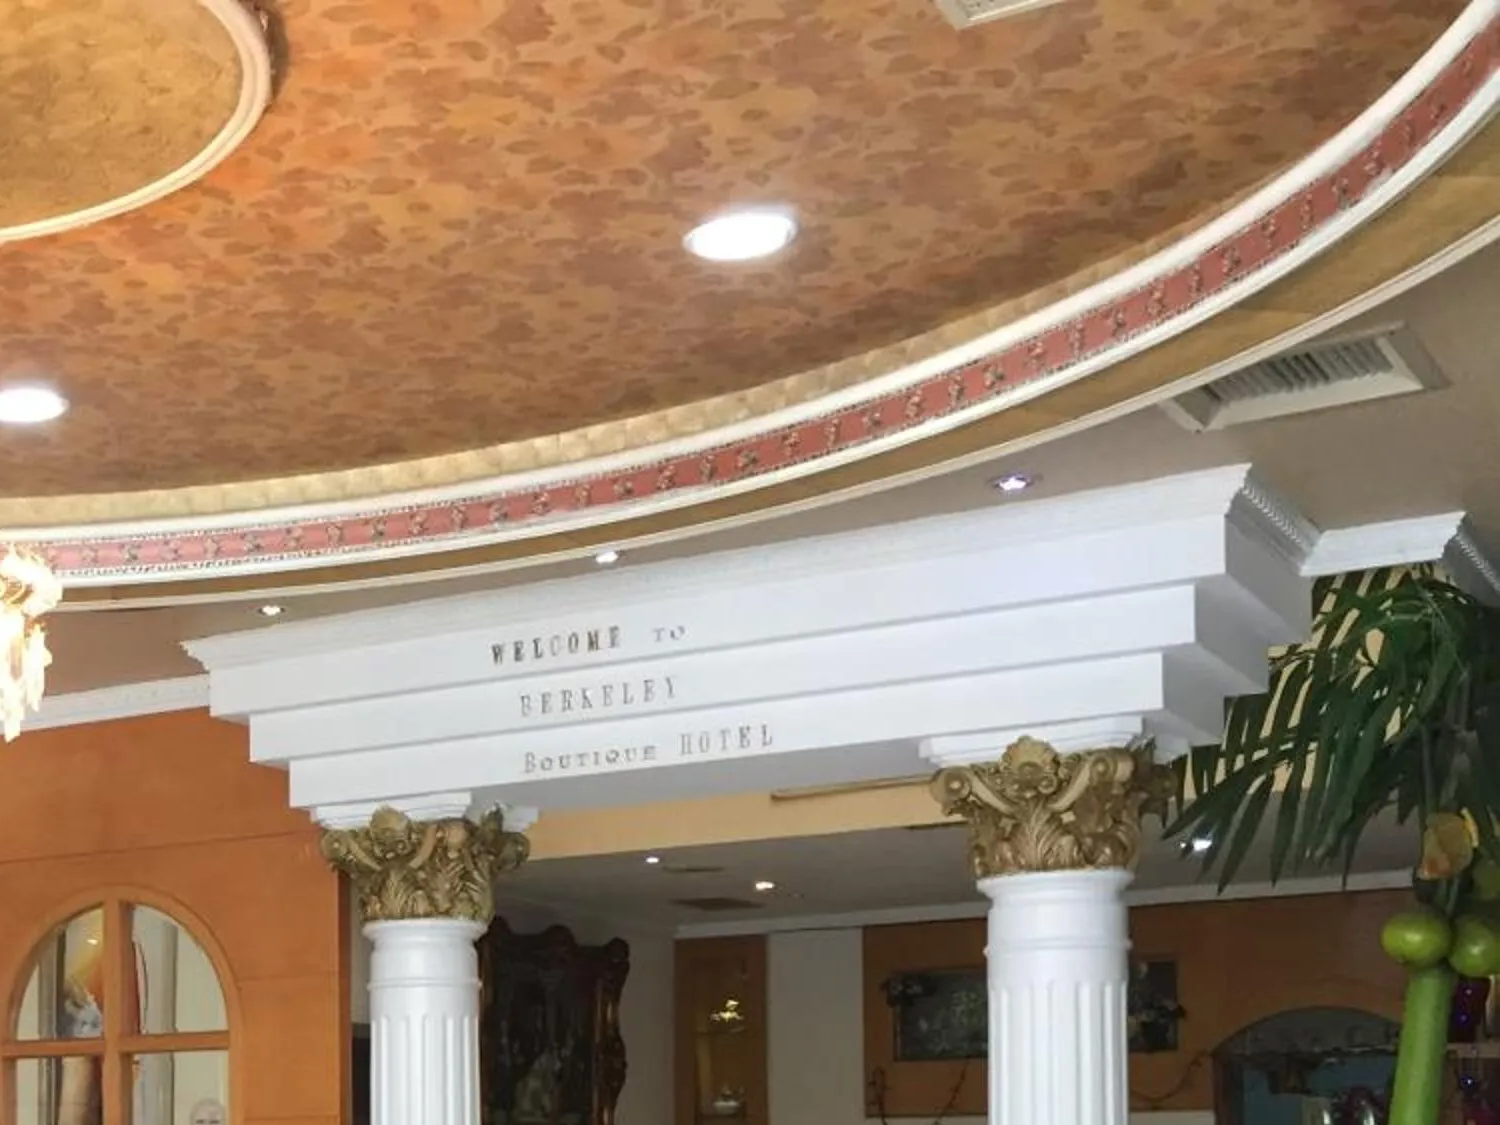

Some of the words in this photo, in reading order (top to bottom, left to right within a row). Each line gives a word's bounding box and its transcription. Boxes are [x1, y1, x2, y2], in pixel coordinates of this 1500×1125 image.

[490, 626, 622, 666] WELCOME
[519, 675, 680, 718] BERKELEY
[679, 724, 774, 757] HOTEL
